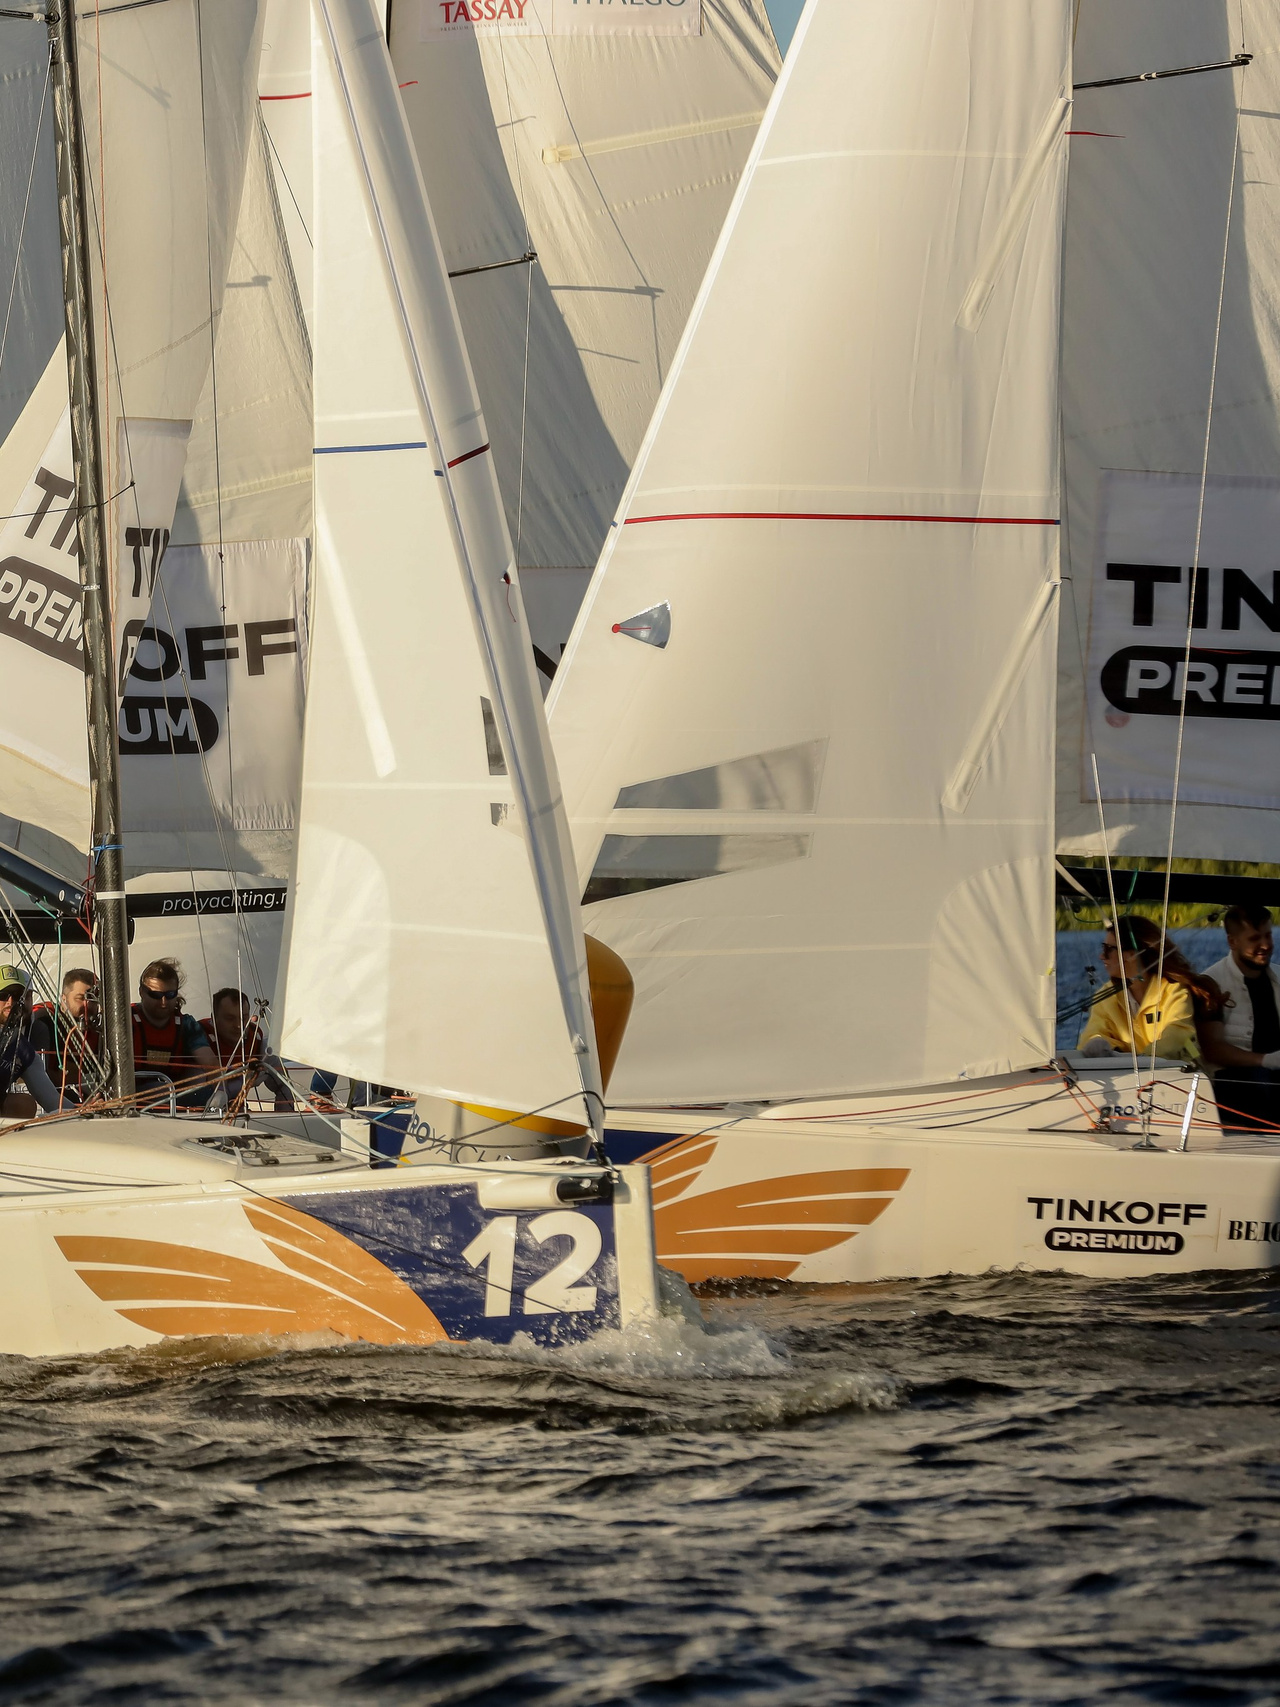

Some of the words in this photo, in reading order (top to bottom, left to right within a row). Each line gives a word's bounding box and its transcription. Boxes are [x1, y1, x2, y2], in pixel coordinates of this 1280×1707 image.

[1125, 659, 1280, 706] PRE
[1027, 1196, 1207, 1226] TINKOFF
[1052, 1231, 1176, 1251] PREMIUM
[461, 1211, 603, 1318] 12
